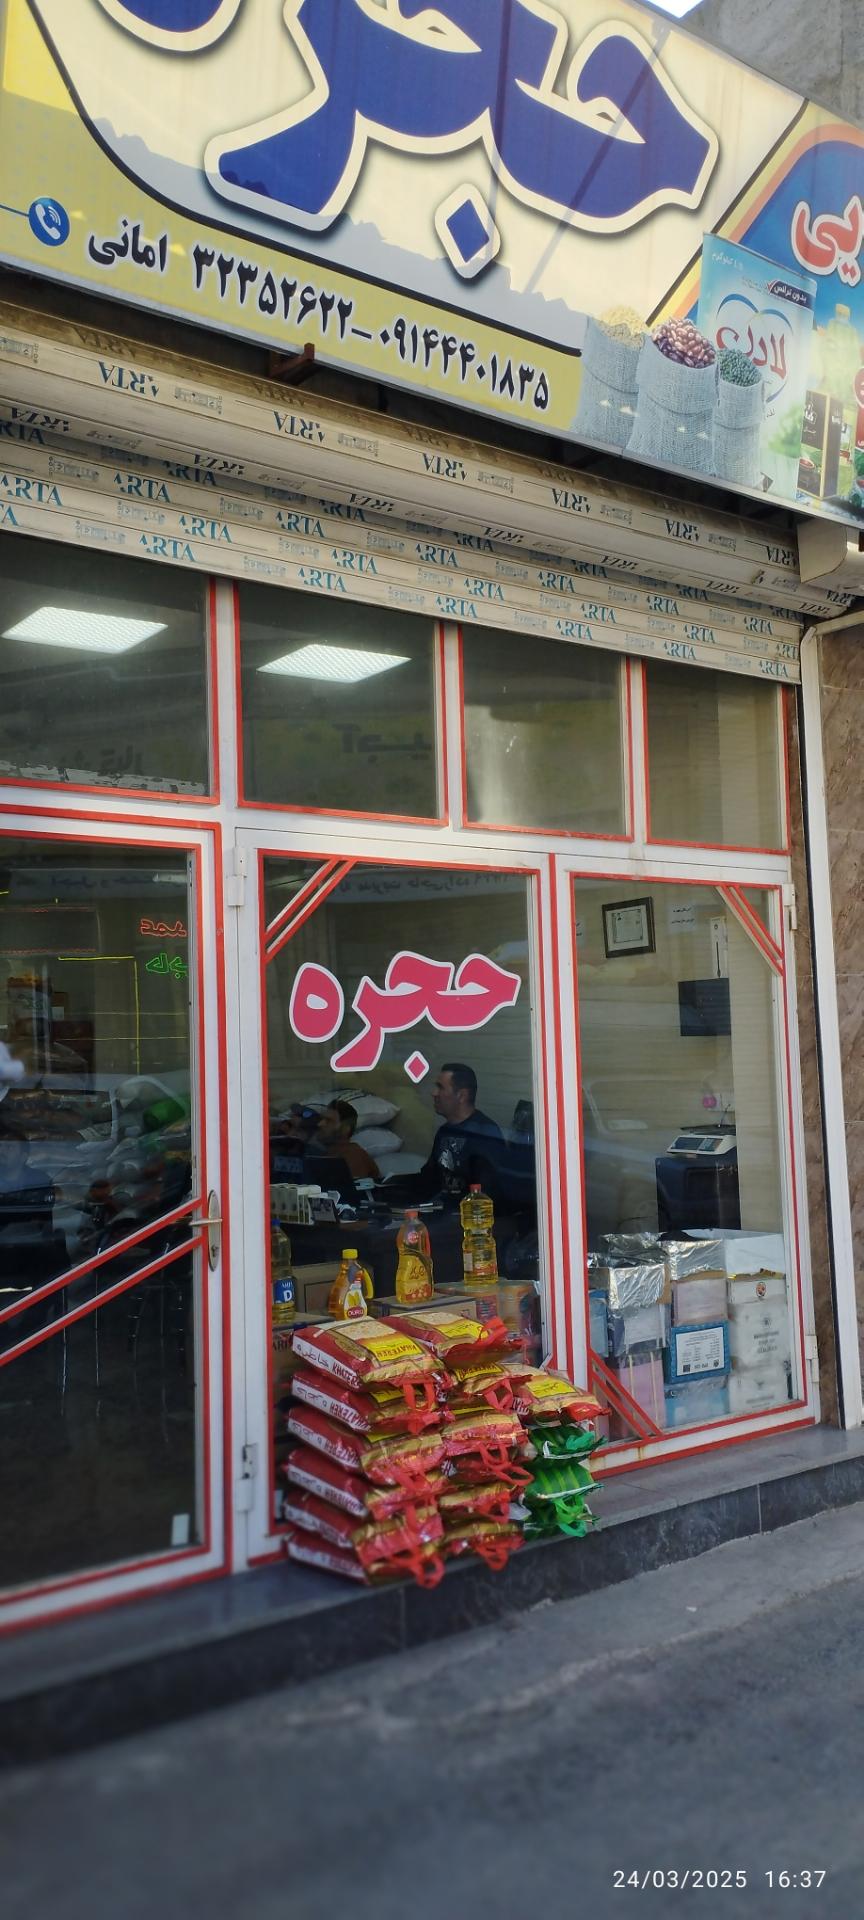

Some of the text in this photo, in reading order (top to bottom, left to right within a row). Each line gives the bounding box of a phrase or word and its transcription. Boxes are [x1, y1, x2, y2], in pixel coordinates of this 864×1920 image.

[100, 0, 718, 279] حجر
[88, 219, 167, 272] امانی
[773, 284, 792, 297] ترانس
[791, 291, 807, 304] بدون
[98, 361, 160, 397] ARTA
[273, 411, 325, 442] ARTA
[422, 453, 468, 481] ARTA
[0, 474, 63, 507] ARTA
[114, 472, 171, 503] ARTA
[551, 488, 591, 514] ARTA
[178, 514, 232, 544] ARTA
[276, 511, 325, 538] ARTA
[665, 519, 700, 541] ARTA
[140, 533, 195, 562] ARTA
[415, 543, 459, 568] ARTA
[331, 549, 378, 575] ARTA
[298, 567, 347, 592] ARTA
[463, 578, 504, 601] ARTA
[538, 571, 575, 593] ARTA
[436, 596, 478, 617] ARTA
[581, 603, 617, 623] ARTA
[646, 596, 679, 615] ARTA
[555, 621, 592, 640] ARTA
[683, 623, 715, 643] ARTA
[743, 616, 772, 635] ARTA
[663, 641, 696, 660] ARTA
[776, 644, 799, 659] ART
[758, 660, 788, 677] ARTA
[289, 950, 521, 1083] حجره
